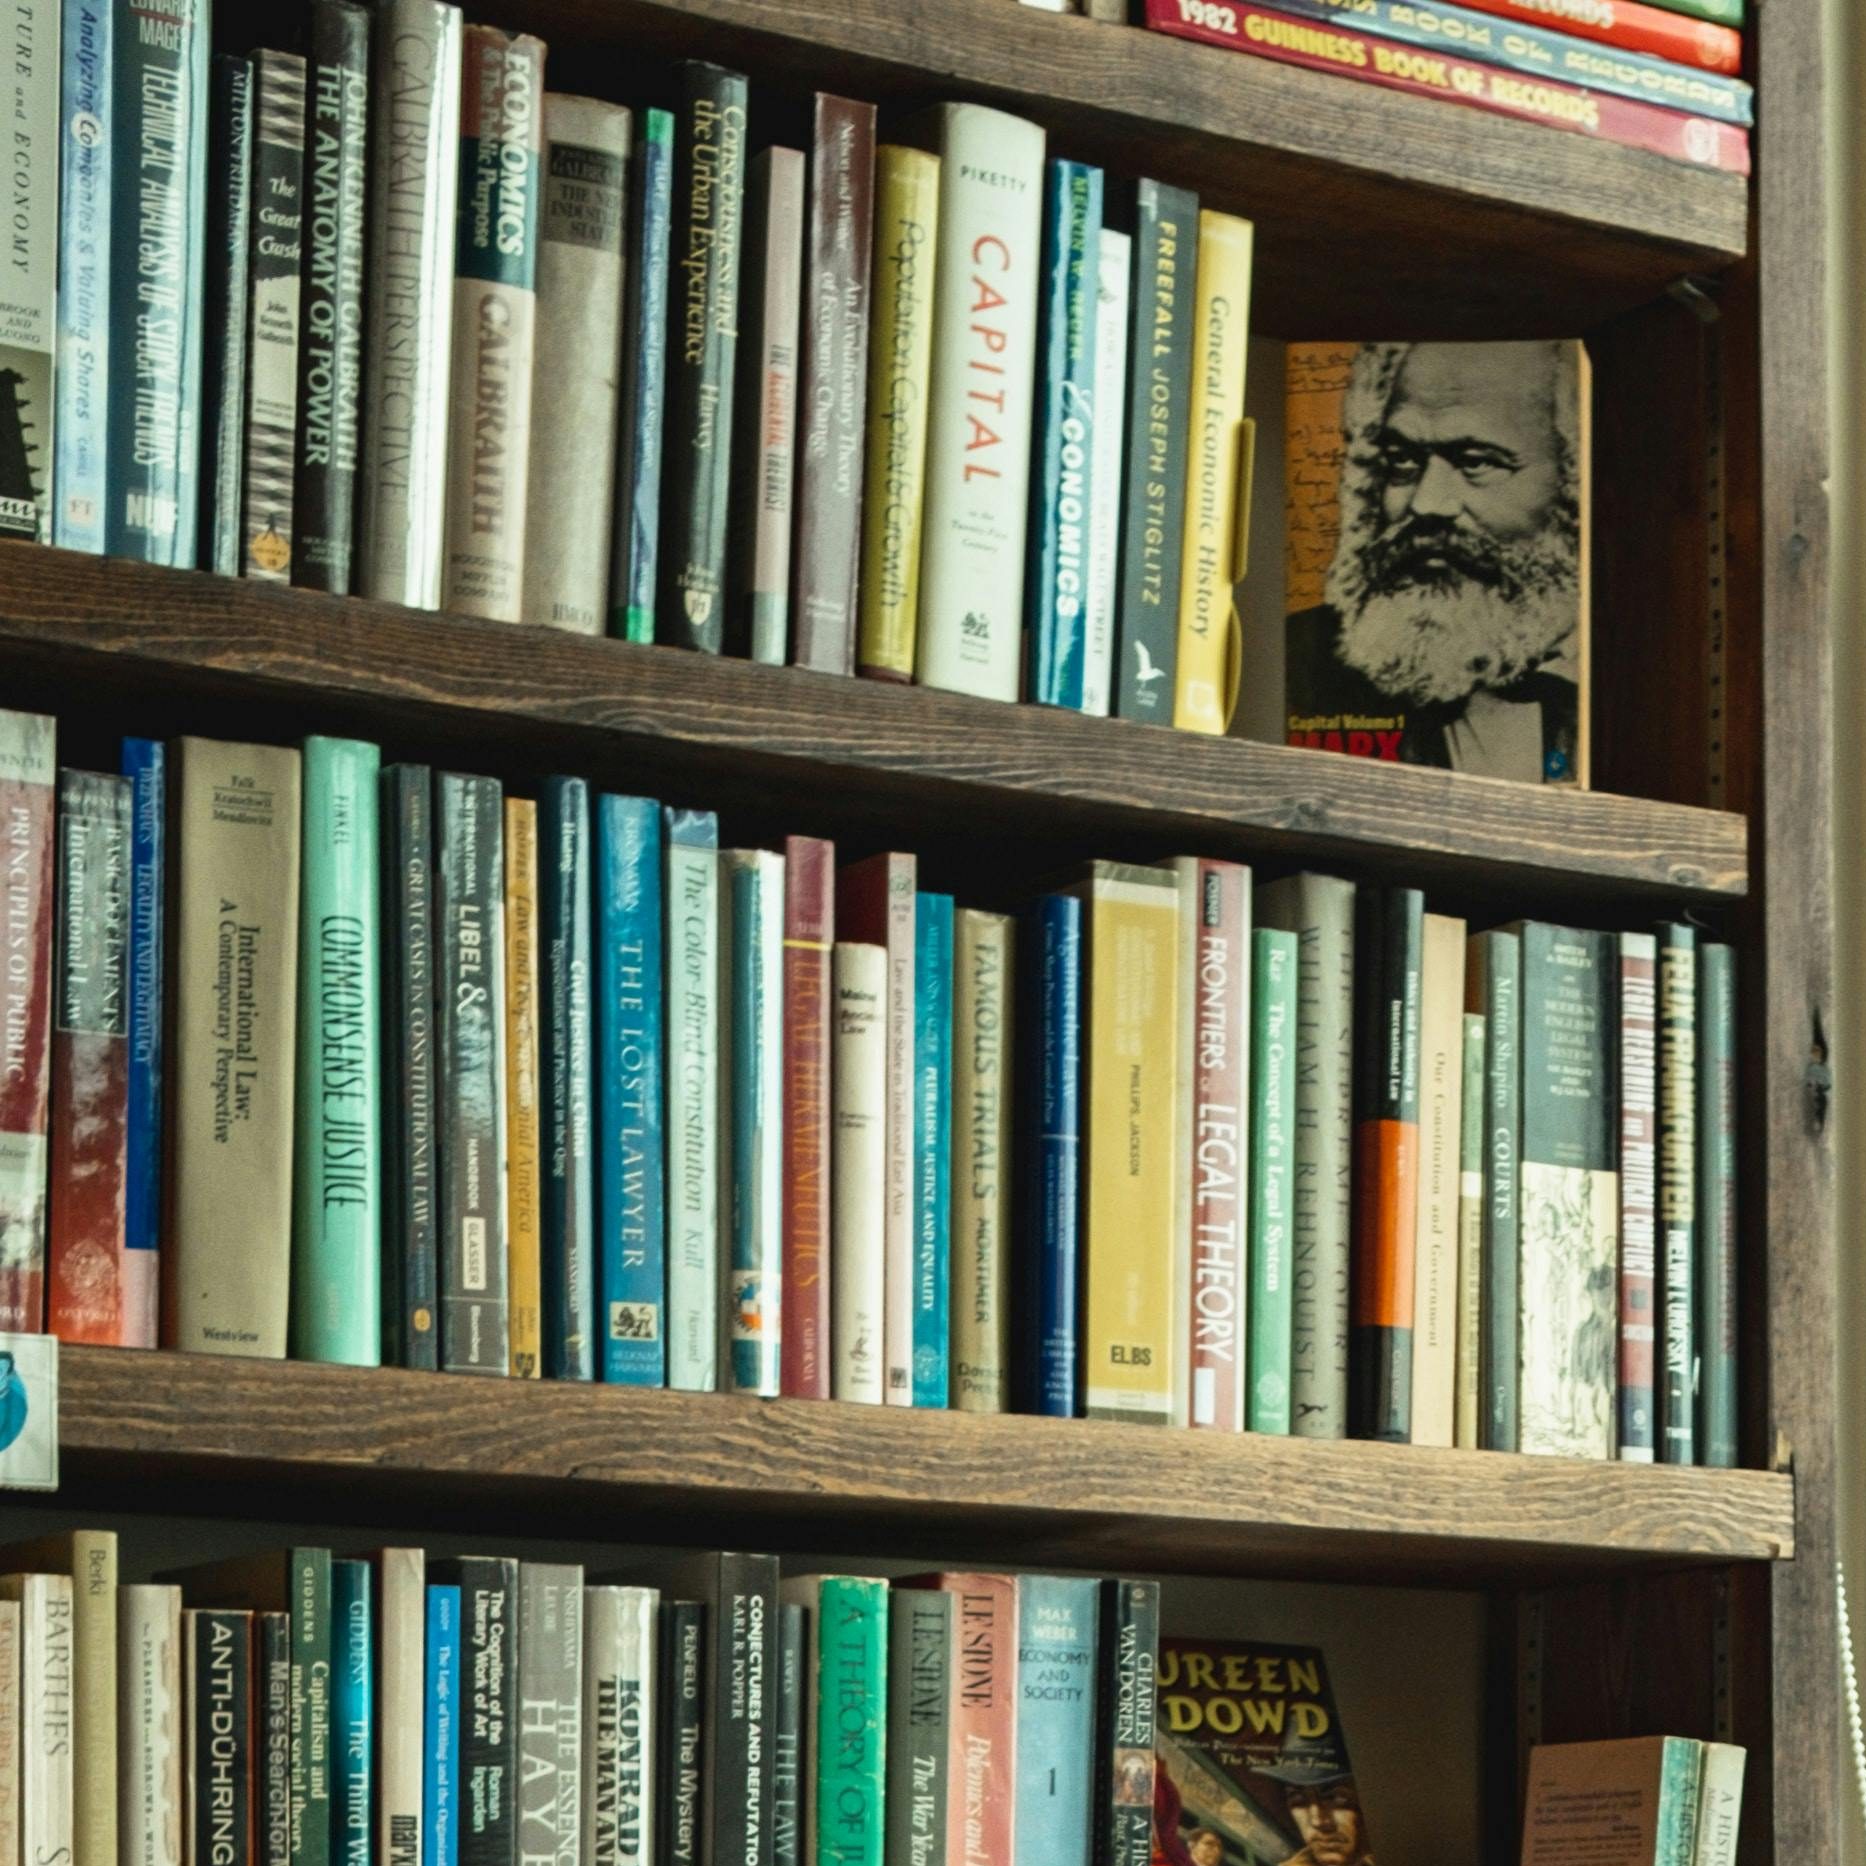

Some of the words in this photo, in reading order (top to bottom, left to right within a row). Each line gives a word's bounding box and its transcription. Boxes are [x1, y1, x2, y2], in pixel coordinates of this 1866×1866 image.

[317, 62, 341, 122] THE
[1179, 0, 1238, 35] 1982
[1245, 15, 1366, 67] GUINNESS
[1376, 42, 1447, 89] BOOK
[1451, 59, 1483, 96] OF
[1491, 74, 1599, 132] RECORDS
[497, 52, 531, 258] ECONOMICS
[960, 165, 1027, 192] PIKETTY
[308, 130, 340, 295] ANATOMY
[308, 300, 334, 340] OF
[1153, 220, 1177, 358] FREEFALL
[963, 235, 1009, 485] CAPITAL
[1209, 295, 1230, 400] General
[304, 348, 333, 467] POWER
[472, 295, 509, 534] GALBRAITH
[1146, 367, 1169, 472] JOSEPH
[1201, 408, 1226, 534] Economic
[1142, 482, 1166, 607] STIGLITZ
[1188, 544, 1221, 641] History
[321, 915, 366, 1103] COMMONSENSE
[620, 941, 646, 1010] THE
[1200, 936, 1227, 1070] FRONTIERS
[620, 1027, 647, 1114] LOST
[323, 1114, 368, 1209] JUSTICE
[621, 1127, 647, 1269] LAWYER
[1198, 1102, 1237, 1208] LEGAL
[1195, 1220, 1234, 1362] THEORY
[749, 1594, 764, 1720] CONJECTURES
[836, 1602, 866, 1626] A
[1018, 1649, 1091, 1667] ECONOMY
[1032, 1626, 1076, 1642] WEBER
[1037, 1608, 1073, 1622] MAX
[836, 1637, 867, 1775] THEORY
[1025, 1685, 1083, 1702] SOCIETY
[1034, 1669, 1068, 1684] AND
[1165, 1695, 1328, 1740] DOWD
[209, 1621, 236, 1866] ANTI-DÜHRING
[350, 1719, 368, 1758] The
[557, 1699, 579, 1758] THE
[748, 1725, 761, 1764] AND
[348, 1771, 368, 1829] Third
[836, 1784, 867, 1829] OF
